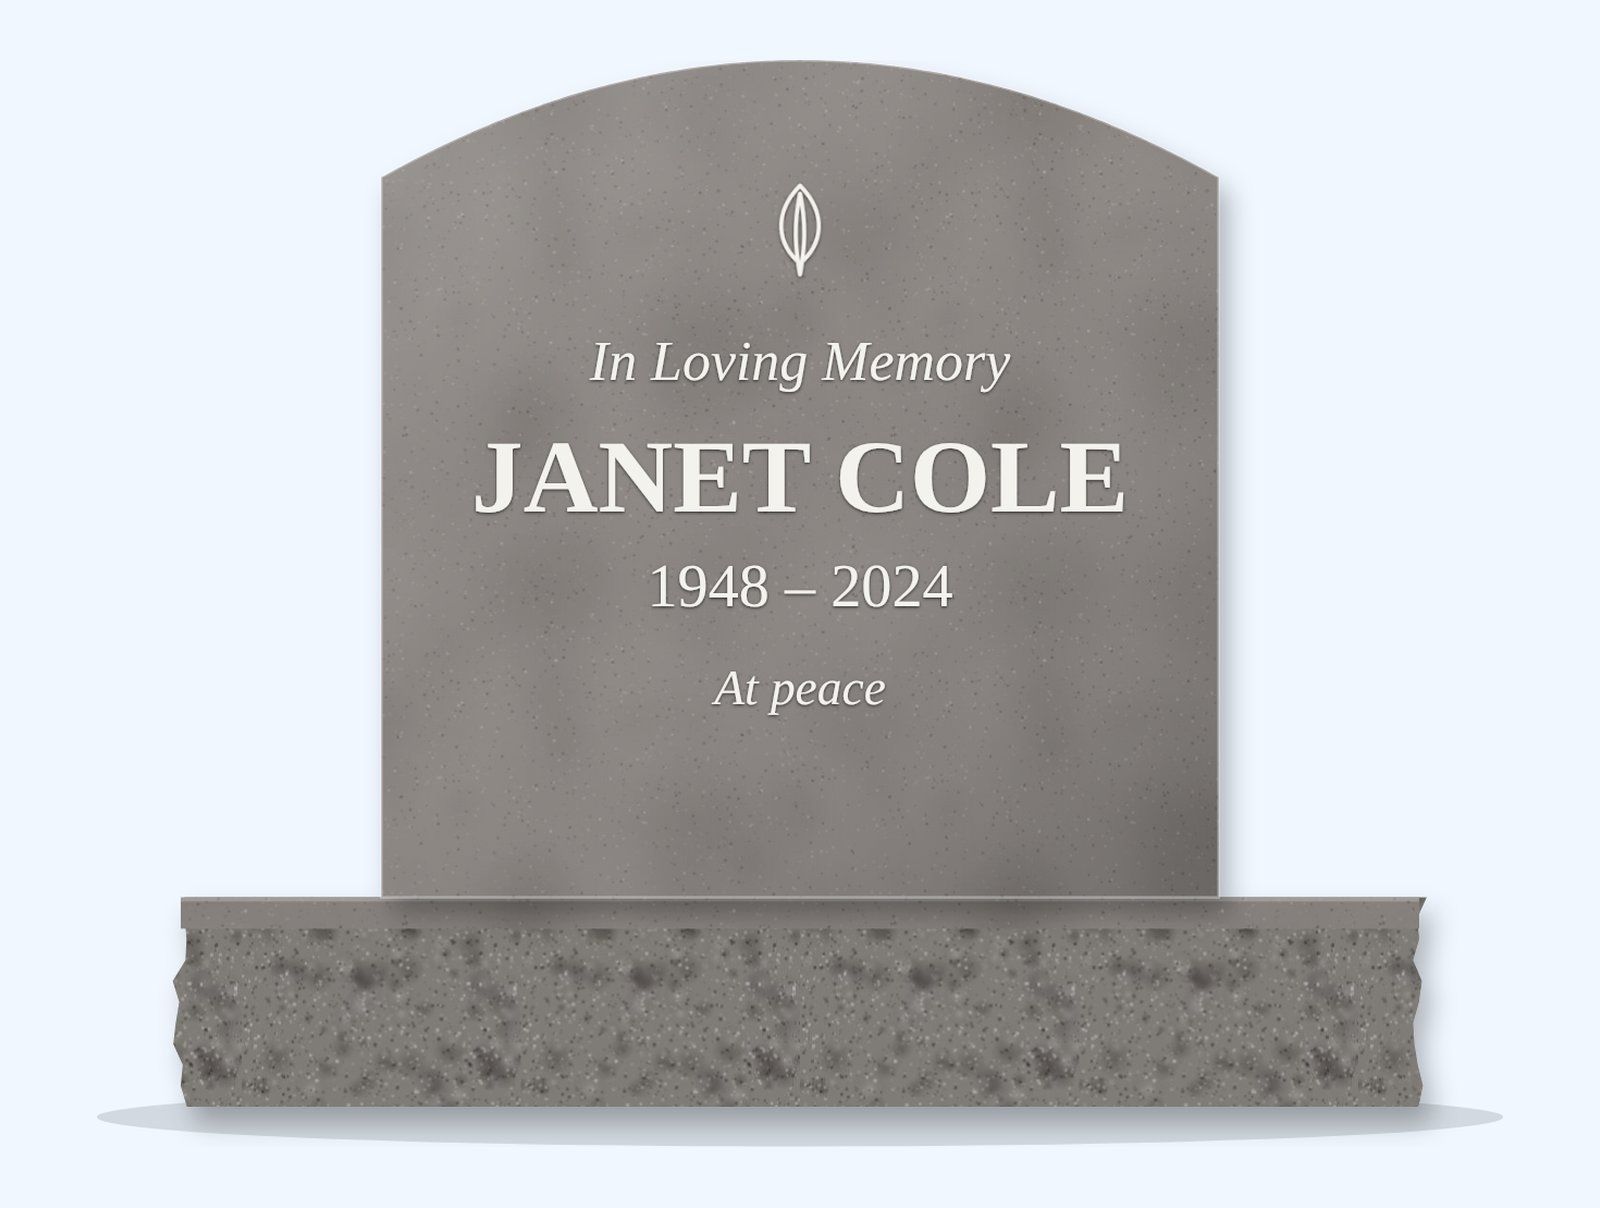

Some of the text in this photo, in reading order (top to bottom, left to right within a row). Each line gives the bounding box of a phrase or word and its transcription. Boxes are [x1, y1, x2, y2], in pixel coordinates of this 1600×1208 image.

[589, 342, 1011, 393] In Loving Memory
[475, 442, 1124, 514] JANET COLE
[652, 565, 768, 608] 1948
[832, 565, 953, 608] 2024
[711, 671, 886, 716] At peace
